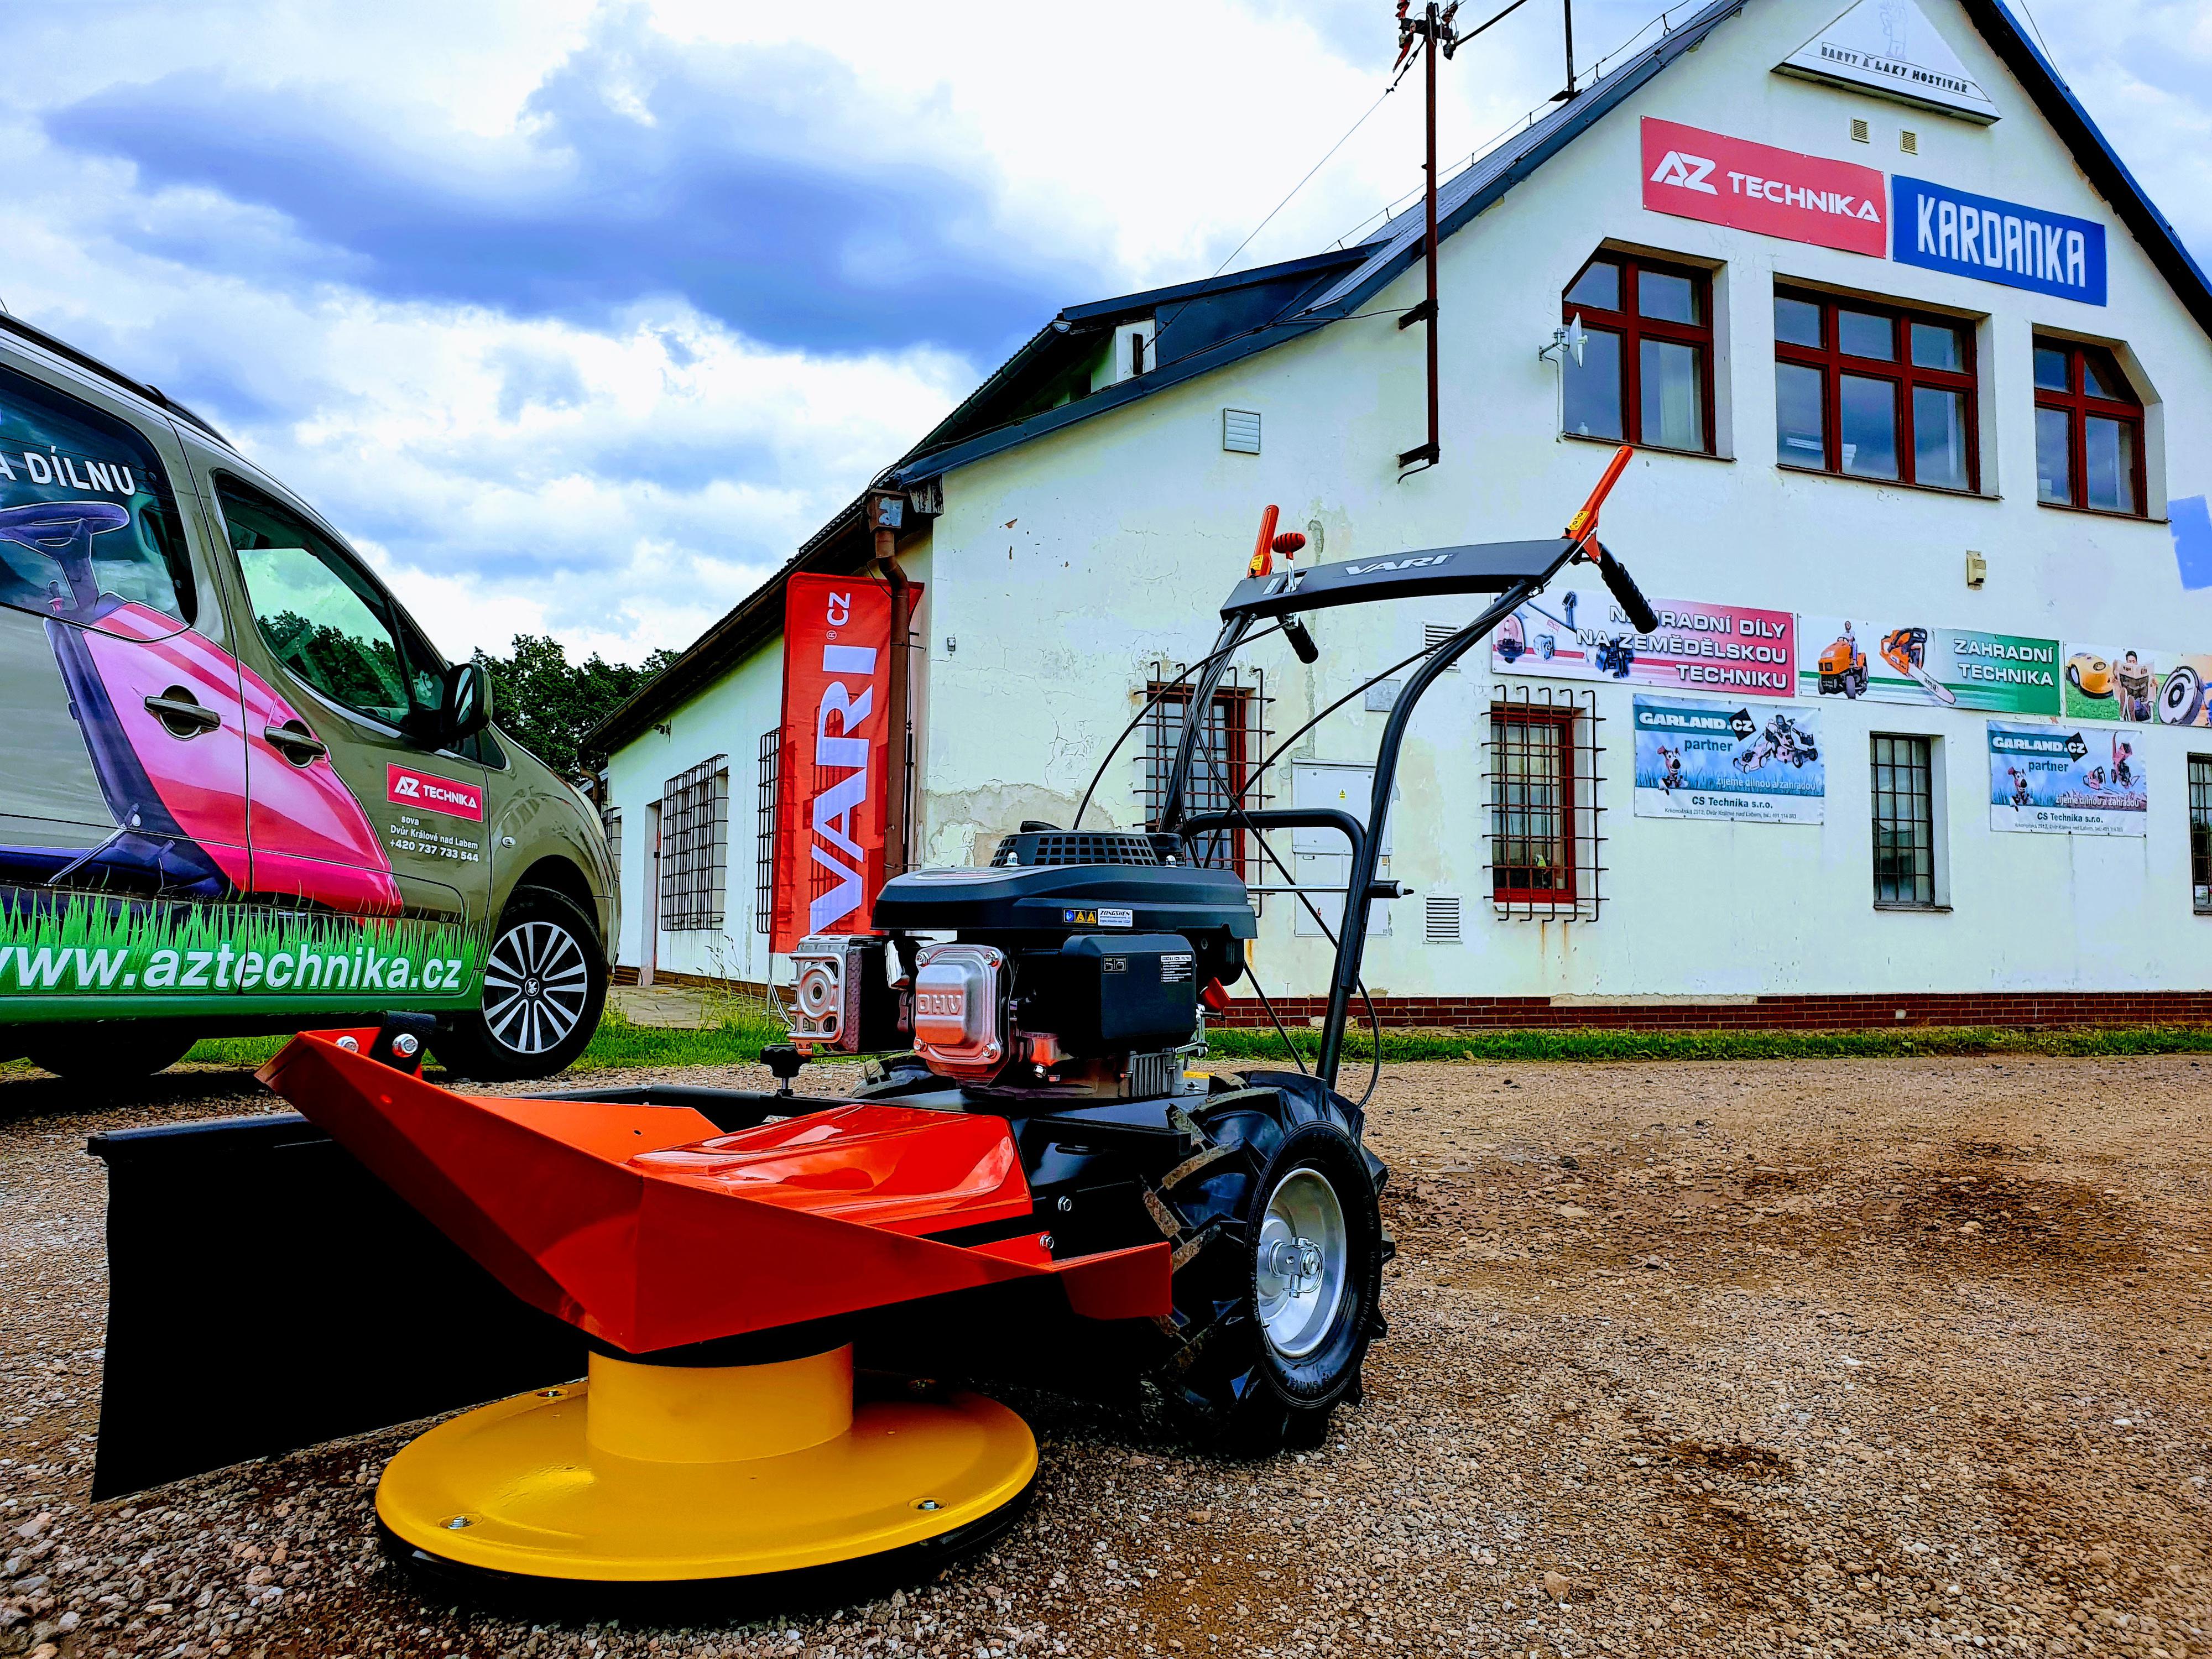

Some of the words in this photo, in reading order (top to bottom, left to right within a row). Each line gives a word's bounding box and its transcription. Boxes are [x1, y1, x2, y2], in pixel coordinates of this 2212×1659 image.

[1822, 47, 1858, 64] BARVY
[1863, 58, 1869, 67] A
[1875, 61, 1907, 76] LAKY
[1650, 150, 1718, 195] AZ
[1727, 170, 1881, 222] TECHNIKA
[1917, 194, 2085, 288] KARDANKA
[23, 445, 135, 495] DÍLNU
[1345, 554, 1449, 575] VARI
[827, 592, 851, 625] CZ
[1610, 606, 1731, 633] NRADNÍ
[1740, 615, 1785, 638] DÍLY
[1577, 629, 1610, 647] NA
[1619, 632, 1787, 663] ZEMĚDĚLSKOU
[1954, 639, 2053, 662] ZAHRADNÍ
[1675, 664, 1787, 689] TECHNIKU
[1958, 663, 2054, 686] TECHNIKA
[1639, 712, 1753, 732] GARLAND.CZ
[1684, 739, 1733, 752] partner
[1992, 737, 2085, 753] GARLAND.CZ
[2028, 761, 2069, 772] partner
[394, 776, 420, 798] AZ
[422, 785, 477, 808] TECHNIKA
[810, 645, 877, 935] VARI
[1692, 796, 1705, 805] CS
[1708, 797, 1749, 807] Technika
[401, 816, 419, 826] sova
[2051, 813, 2083, 822] Technika
[390, 825, 409, 836] Dvůr
[410, 828, 439, 842] Králové
[440, 837, 453, 845] nad
[456, 837, 479, 850] Labem
[390, 839, 415, 851] +420
[419, 843, 437, 854] 737
[440, 847, 458, 859] 733
[461, 851, 479, 862] 544
[0, 942, 462, 989] ww.aztechnika.cz
[917, 994, 962, 1015] OHV
